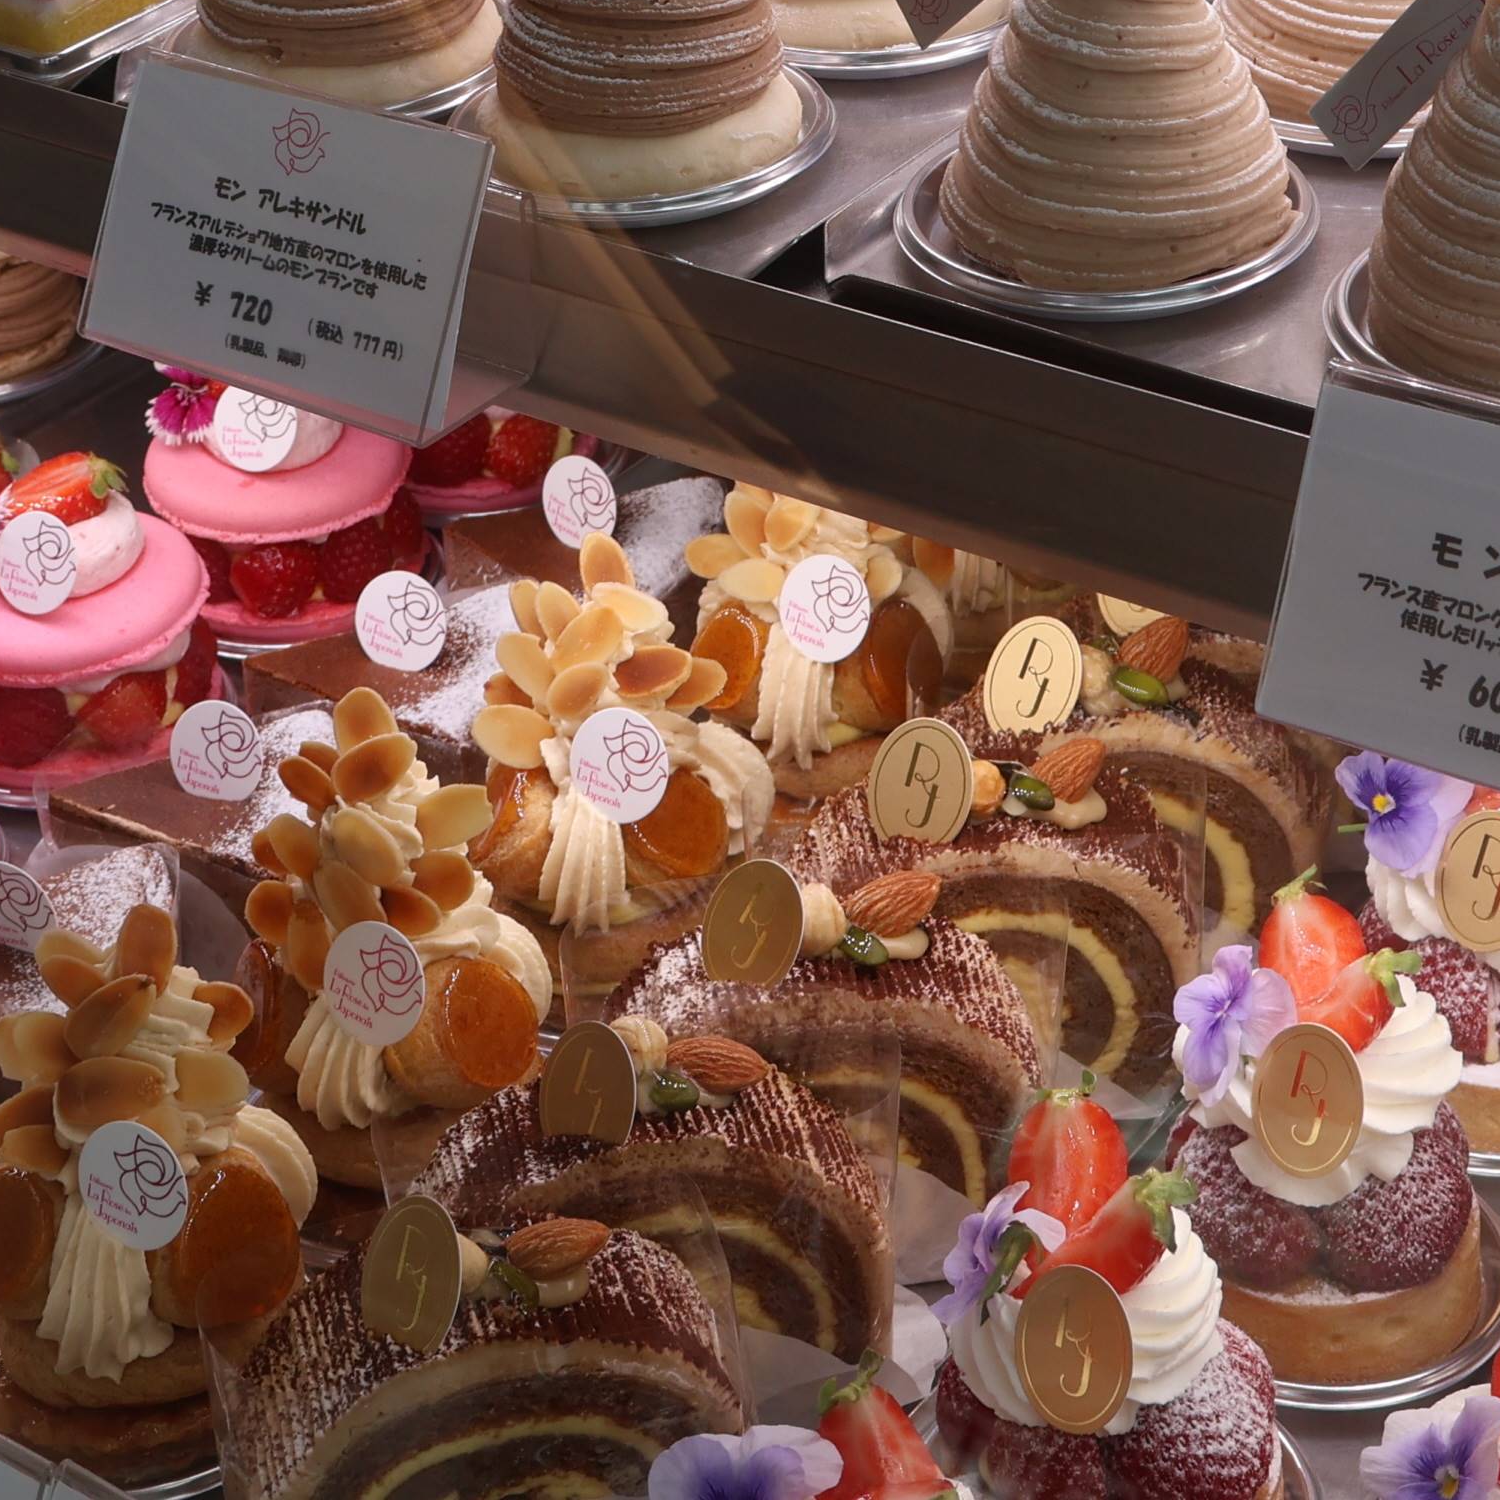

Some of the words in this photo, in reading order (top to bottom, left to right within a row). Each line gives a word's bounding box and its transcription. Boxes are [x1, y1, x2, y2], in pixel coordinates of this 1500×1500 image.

[214, 176, 246, 202] モン
[258, 188, 367, 236] アレキサンドル
[194, 281, 214, 308] ¥
[230, 290, 274, 327] 720
[308, 317, 344, 346] (税込
[353, 331, 405, 363] 777円)
[1418, 658, 1448, 693] ¥
